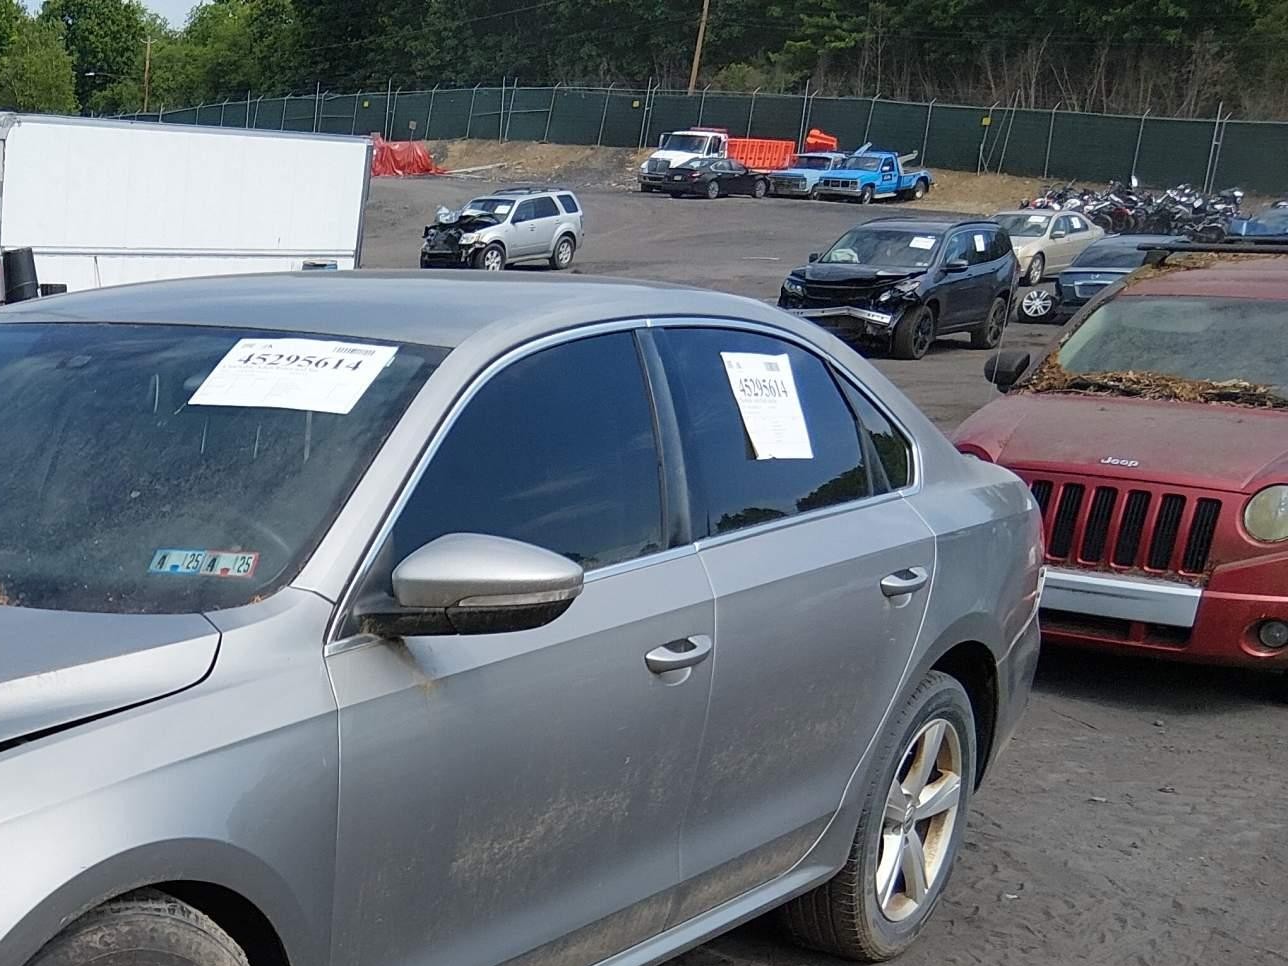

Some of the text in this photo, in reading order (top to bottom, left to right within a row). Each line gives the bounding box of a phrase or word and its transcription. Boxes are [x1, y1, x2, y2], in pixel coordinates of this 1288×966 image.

[237, 352, 364, 371] 45295614
[738, 377, 789, 398] 45295614
[1100, 456, 1139, 468] Jeep
[157, 553, 203, 570] 4 25
[207, 556, 253, 573] 4 25
